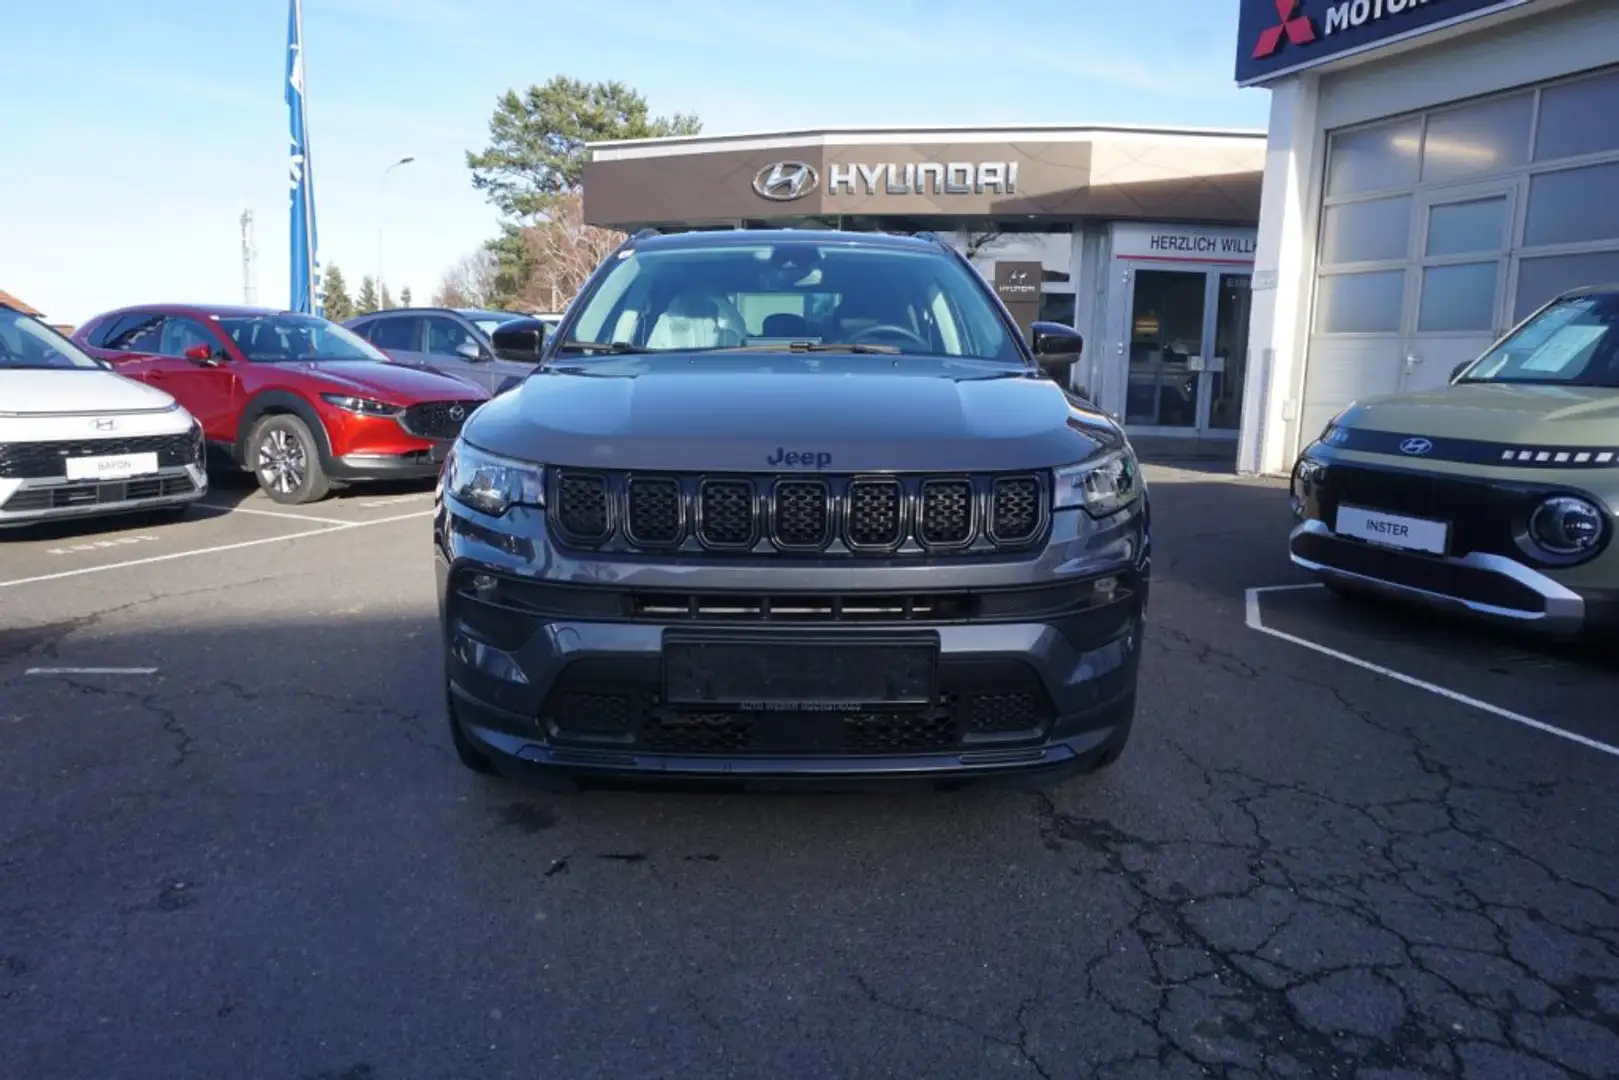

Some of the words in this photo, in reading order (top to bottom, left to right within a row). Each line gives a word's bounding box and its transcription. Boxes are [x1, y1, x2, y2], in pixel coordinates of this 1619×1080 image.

[1324, 0, 1429, 36] MOTO
[828, 161, 1018, 195] HYUNDAI
[1150, 235, 1217, 253] HERZLICH
[766, 447, 832, 470] Jeep
[1366, 519, 1410, 538] INSTER
